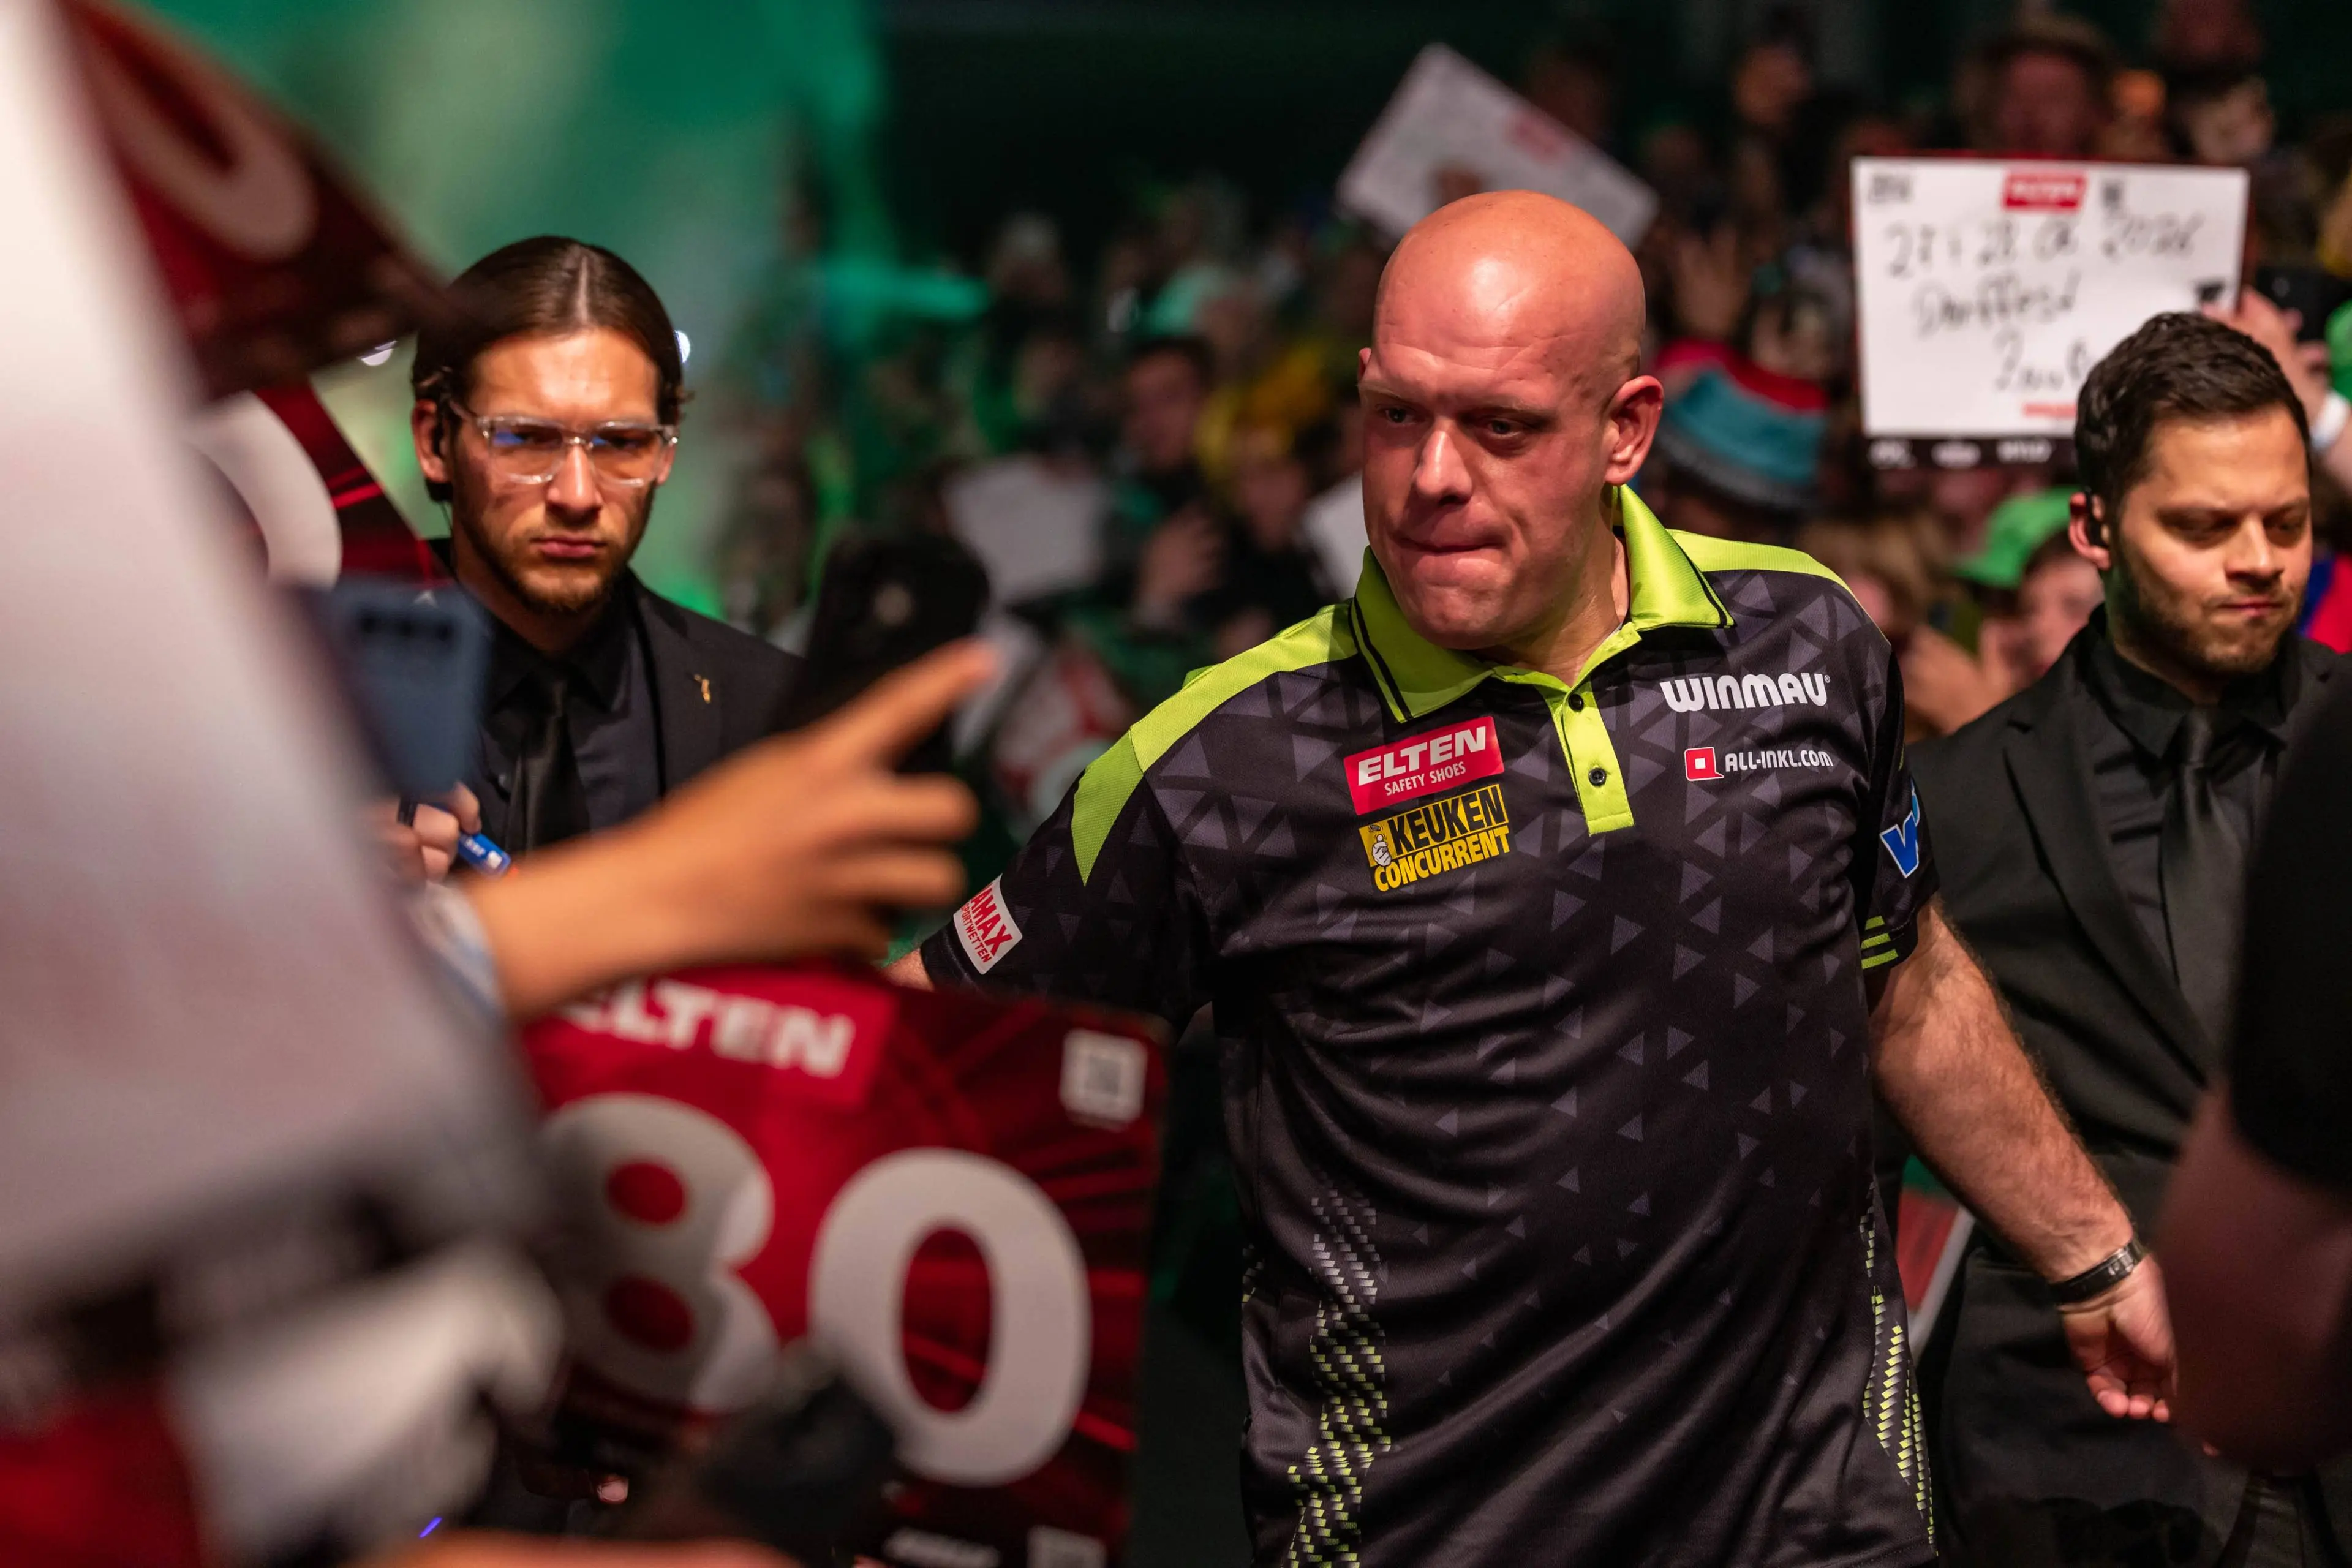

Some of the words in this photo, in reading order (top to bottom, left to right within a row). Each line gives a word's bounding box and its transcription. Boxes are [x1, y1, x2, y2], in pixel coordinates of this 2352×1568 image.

[1660, 673, 1828, 712] WINMAU
[1358, 726, 1486, 786] ELTEN
[1384, 773, 1425, 796] SAFETY
[1431, 761, 1466, 785] SHOES
[1725, 750, 1834, 772] ALL-INKL.COM
[1389, 785, 1506, 856] KEUKEN
[1374, 826, 1510, 892] CONCURRENT
[970, 883, 1013, 956] AMAX
[562, 977, 856, 1079] LTEN
